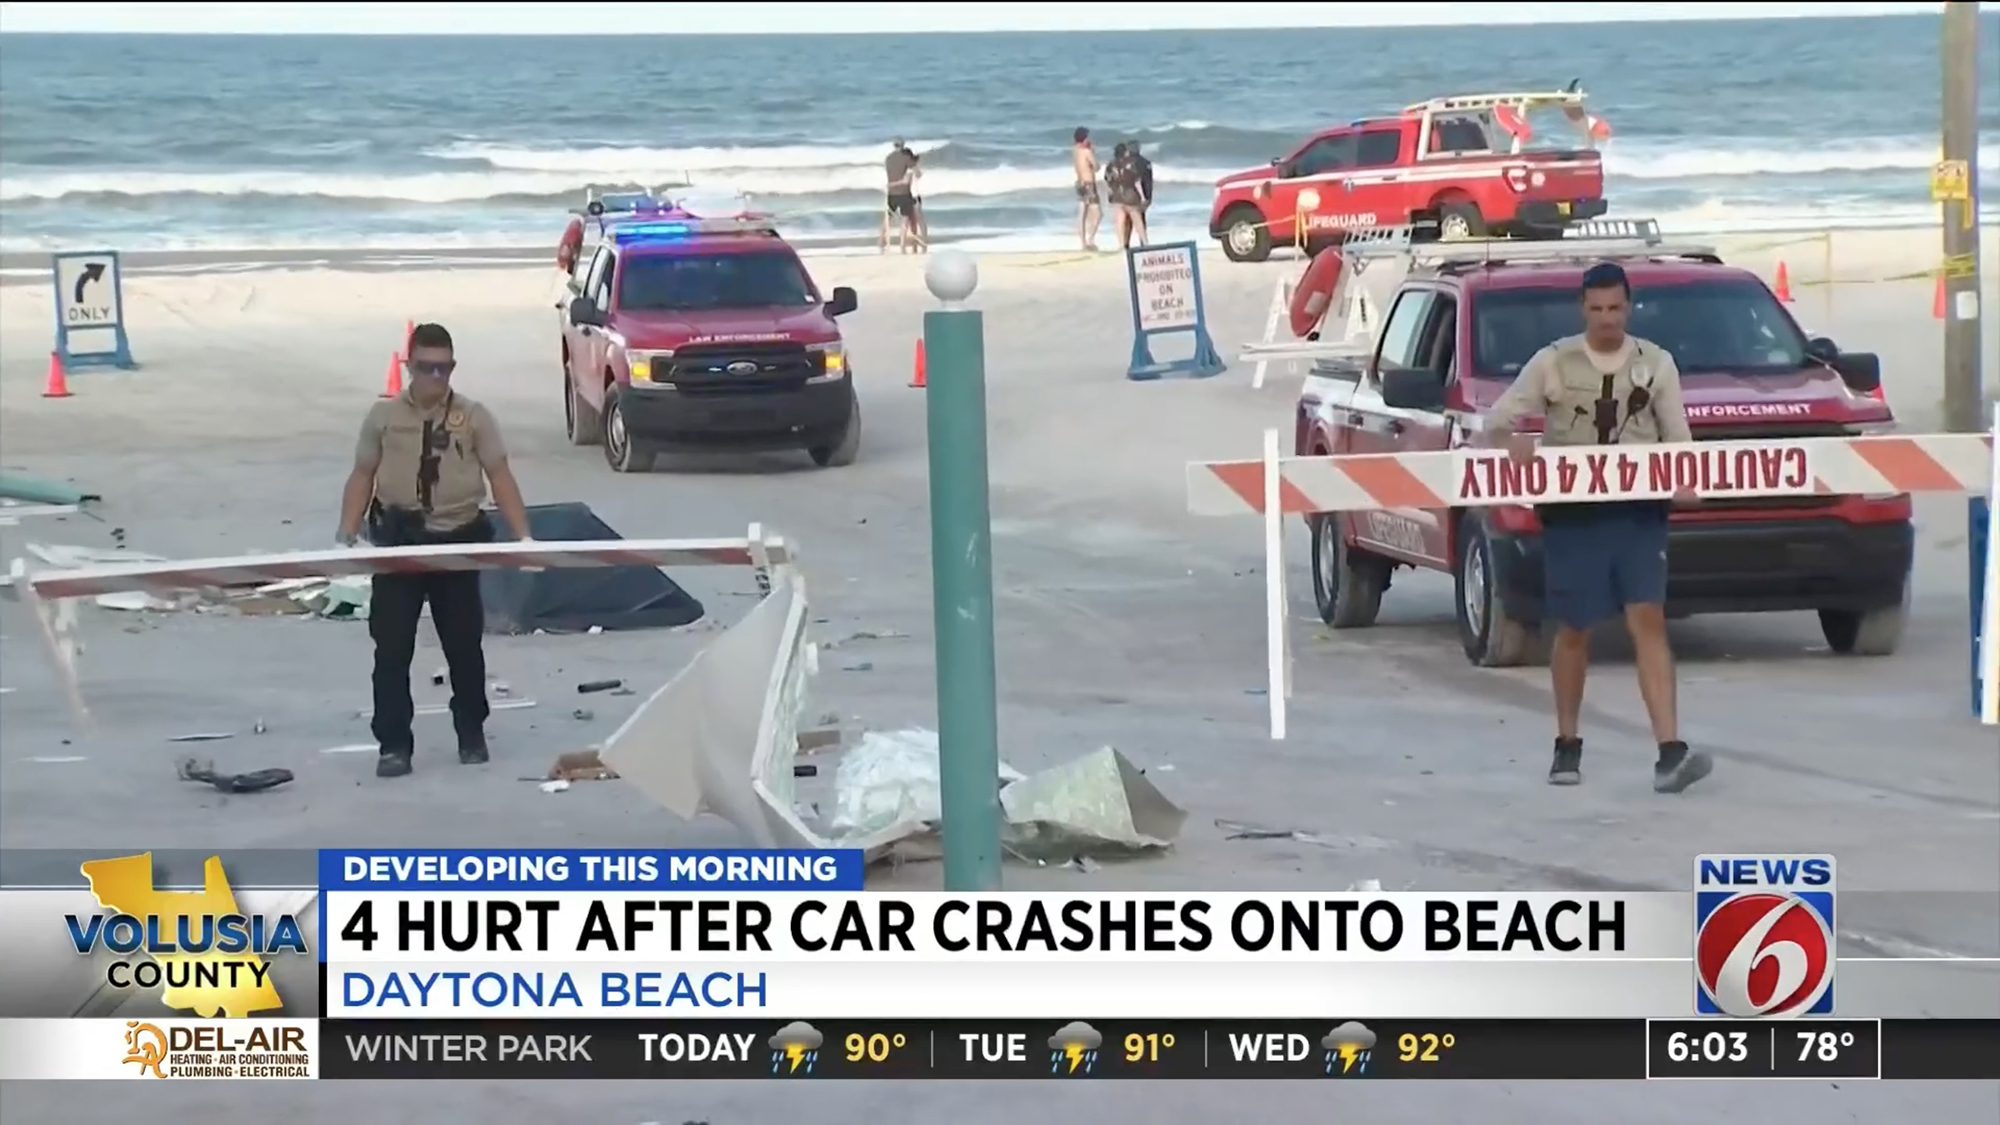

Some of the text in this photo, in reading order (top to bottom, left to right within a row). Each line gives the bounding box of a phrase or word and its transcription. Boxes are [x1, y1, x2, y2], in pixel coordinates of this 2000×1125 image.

[1141, 253, 1184, 267] ANIMALS
[1159, 283, 1174, 296] ON
[1151, 298, 1184, 311] BEACH
[68, 306, 110, 321] ONLY
[1683, 403, 1811, 418] NFORCEMENT
[1460, 447, 1807, 498] CAUTION 4 X 4 ONLY
